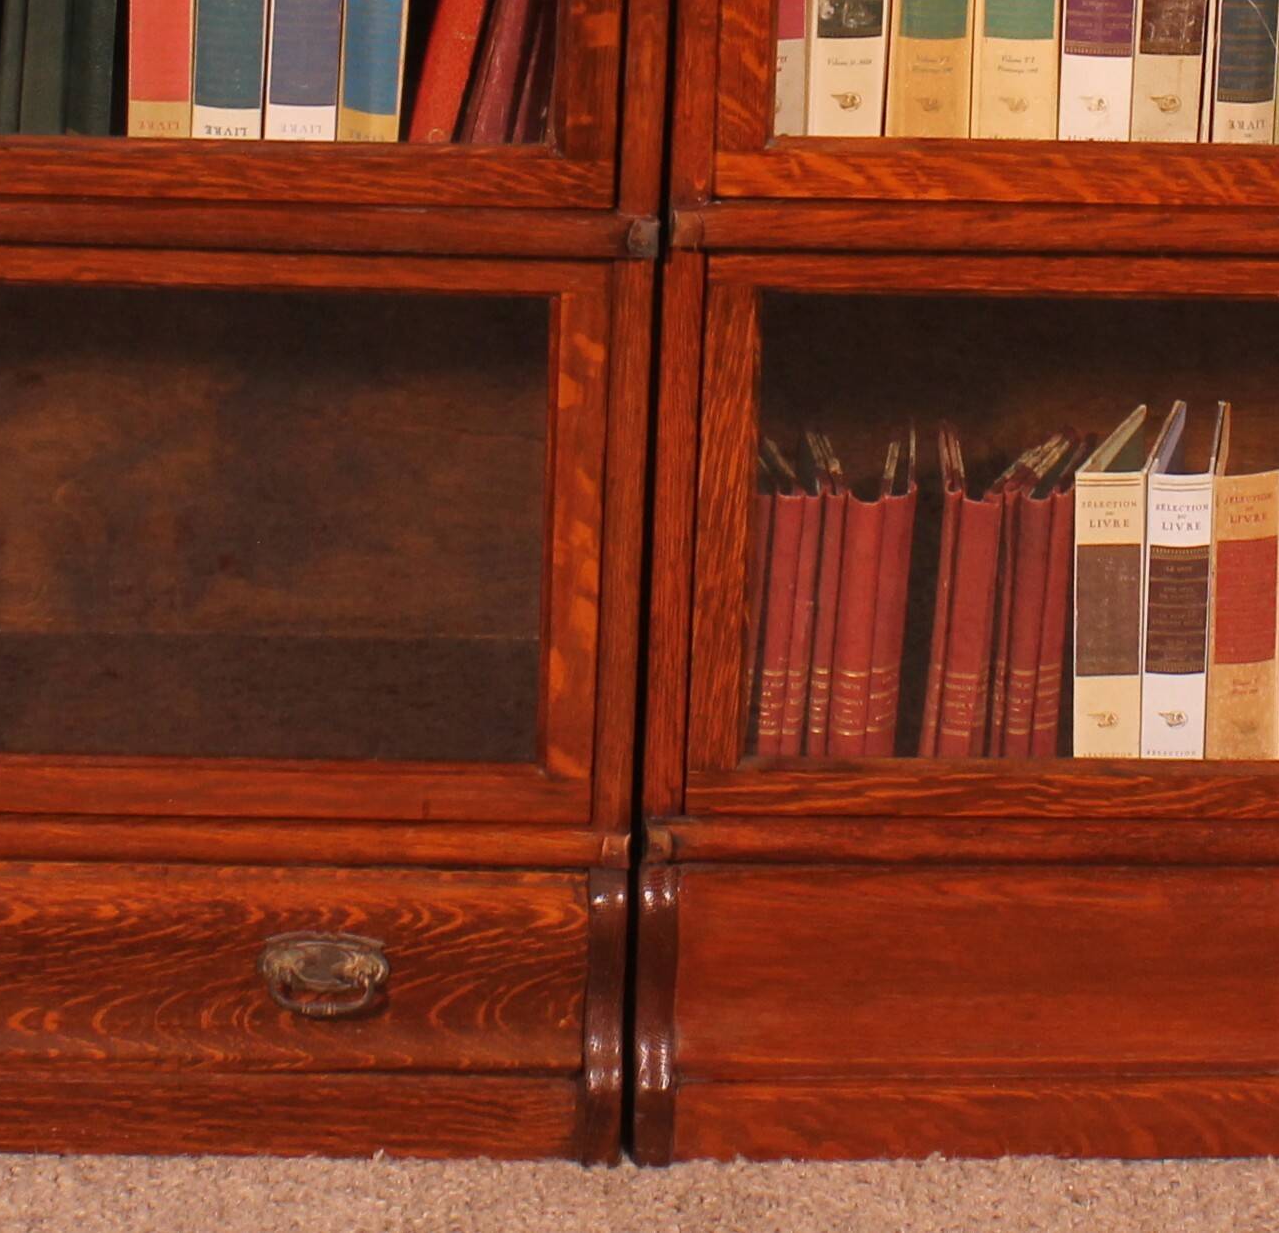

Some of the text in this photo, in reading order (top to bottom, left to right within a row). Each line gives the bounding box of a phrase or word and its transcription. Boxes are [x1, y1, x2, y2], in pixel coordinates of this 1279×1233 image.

[204, 125, 248, 137] LIVRE
[280, 123, 322, 134] LIVRE
[1155, 503, 1210, 513] SÉLECTION
[1088, 518, 1130, 529] LIVRE
[1161, 521, 1202, 532] LIVRE
